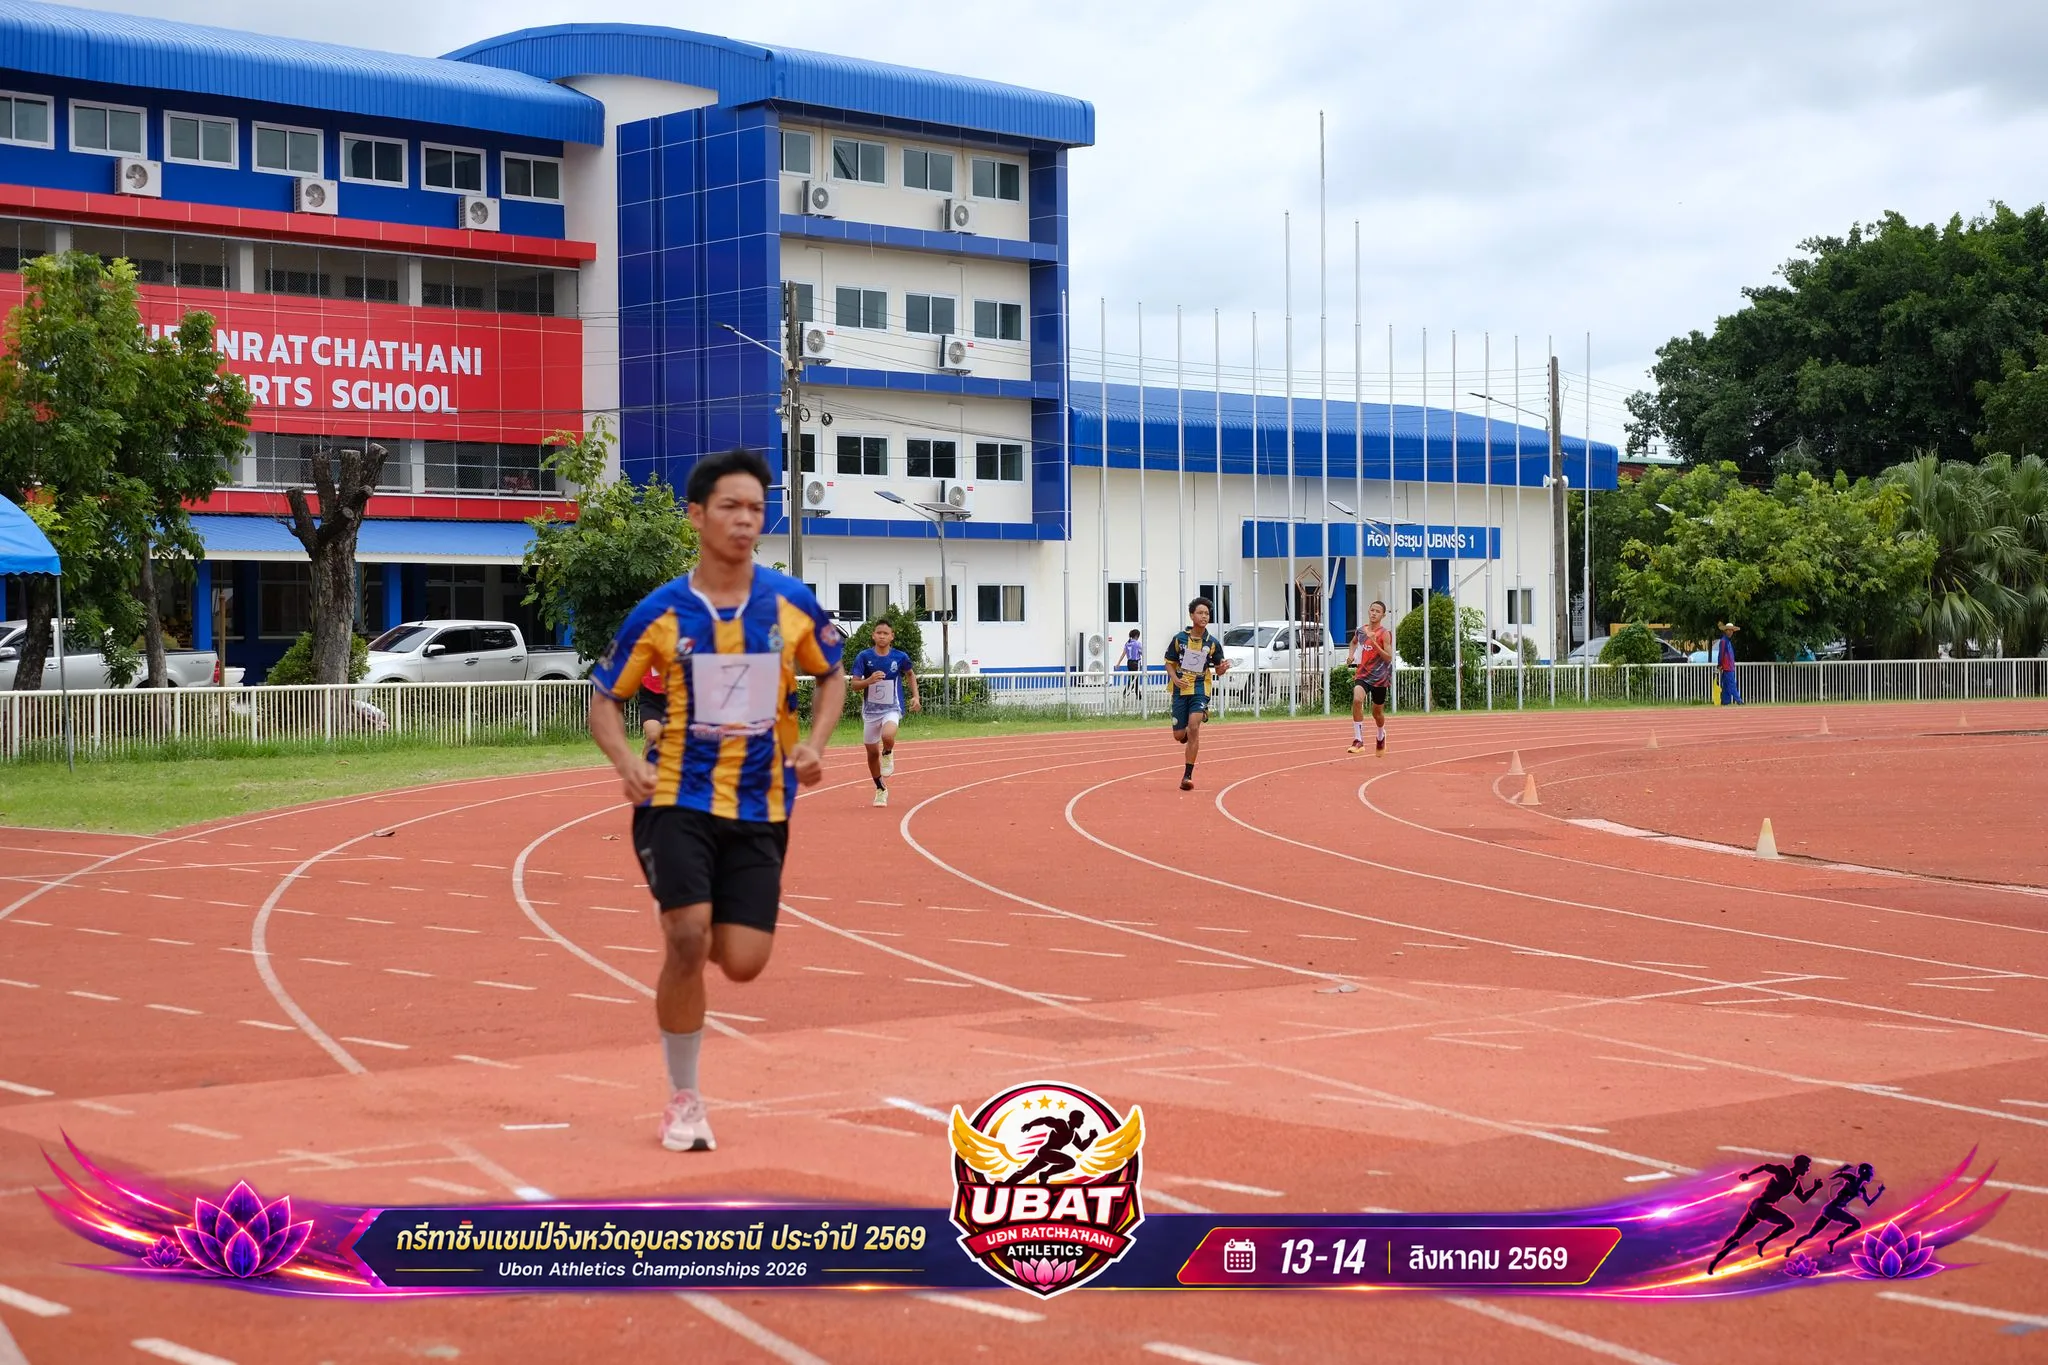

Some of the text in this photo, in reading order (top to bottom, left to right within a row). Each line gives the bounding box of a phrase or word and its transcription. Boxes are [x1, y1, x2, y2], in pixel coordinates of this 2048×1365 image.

[332, 379, 458, 414] SCHOOL
[1427, 533, 1466, 549] UBNSS
[1469, 534, 1475, 549] 1
[1188, 652, 1200, 666] 3
[720, 663, 750, 710] 7
[875, 684, 886, 700] 5
